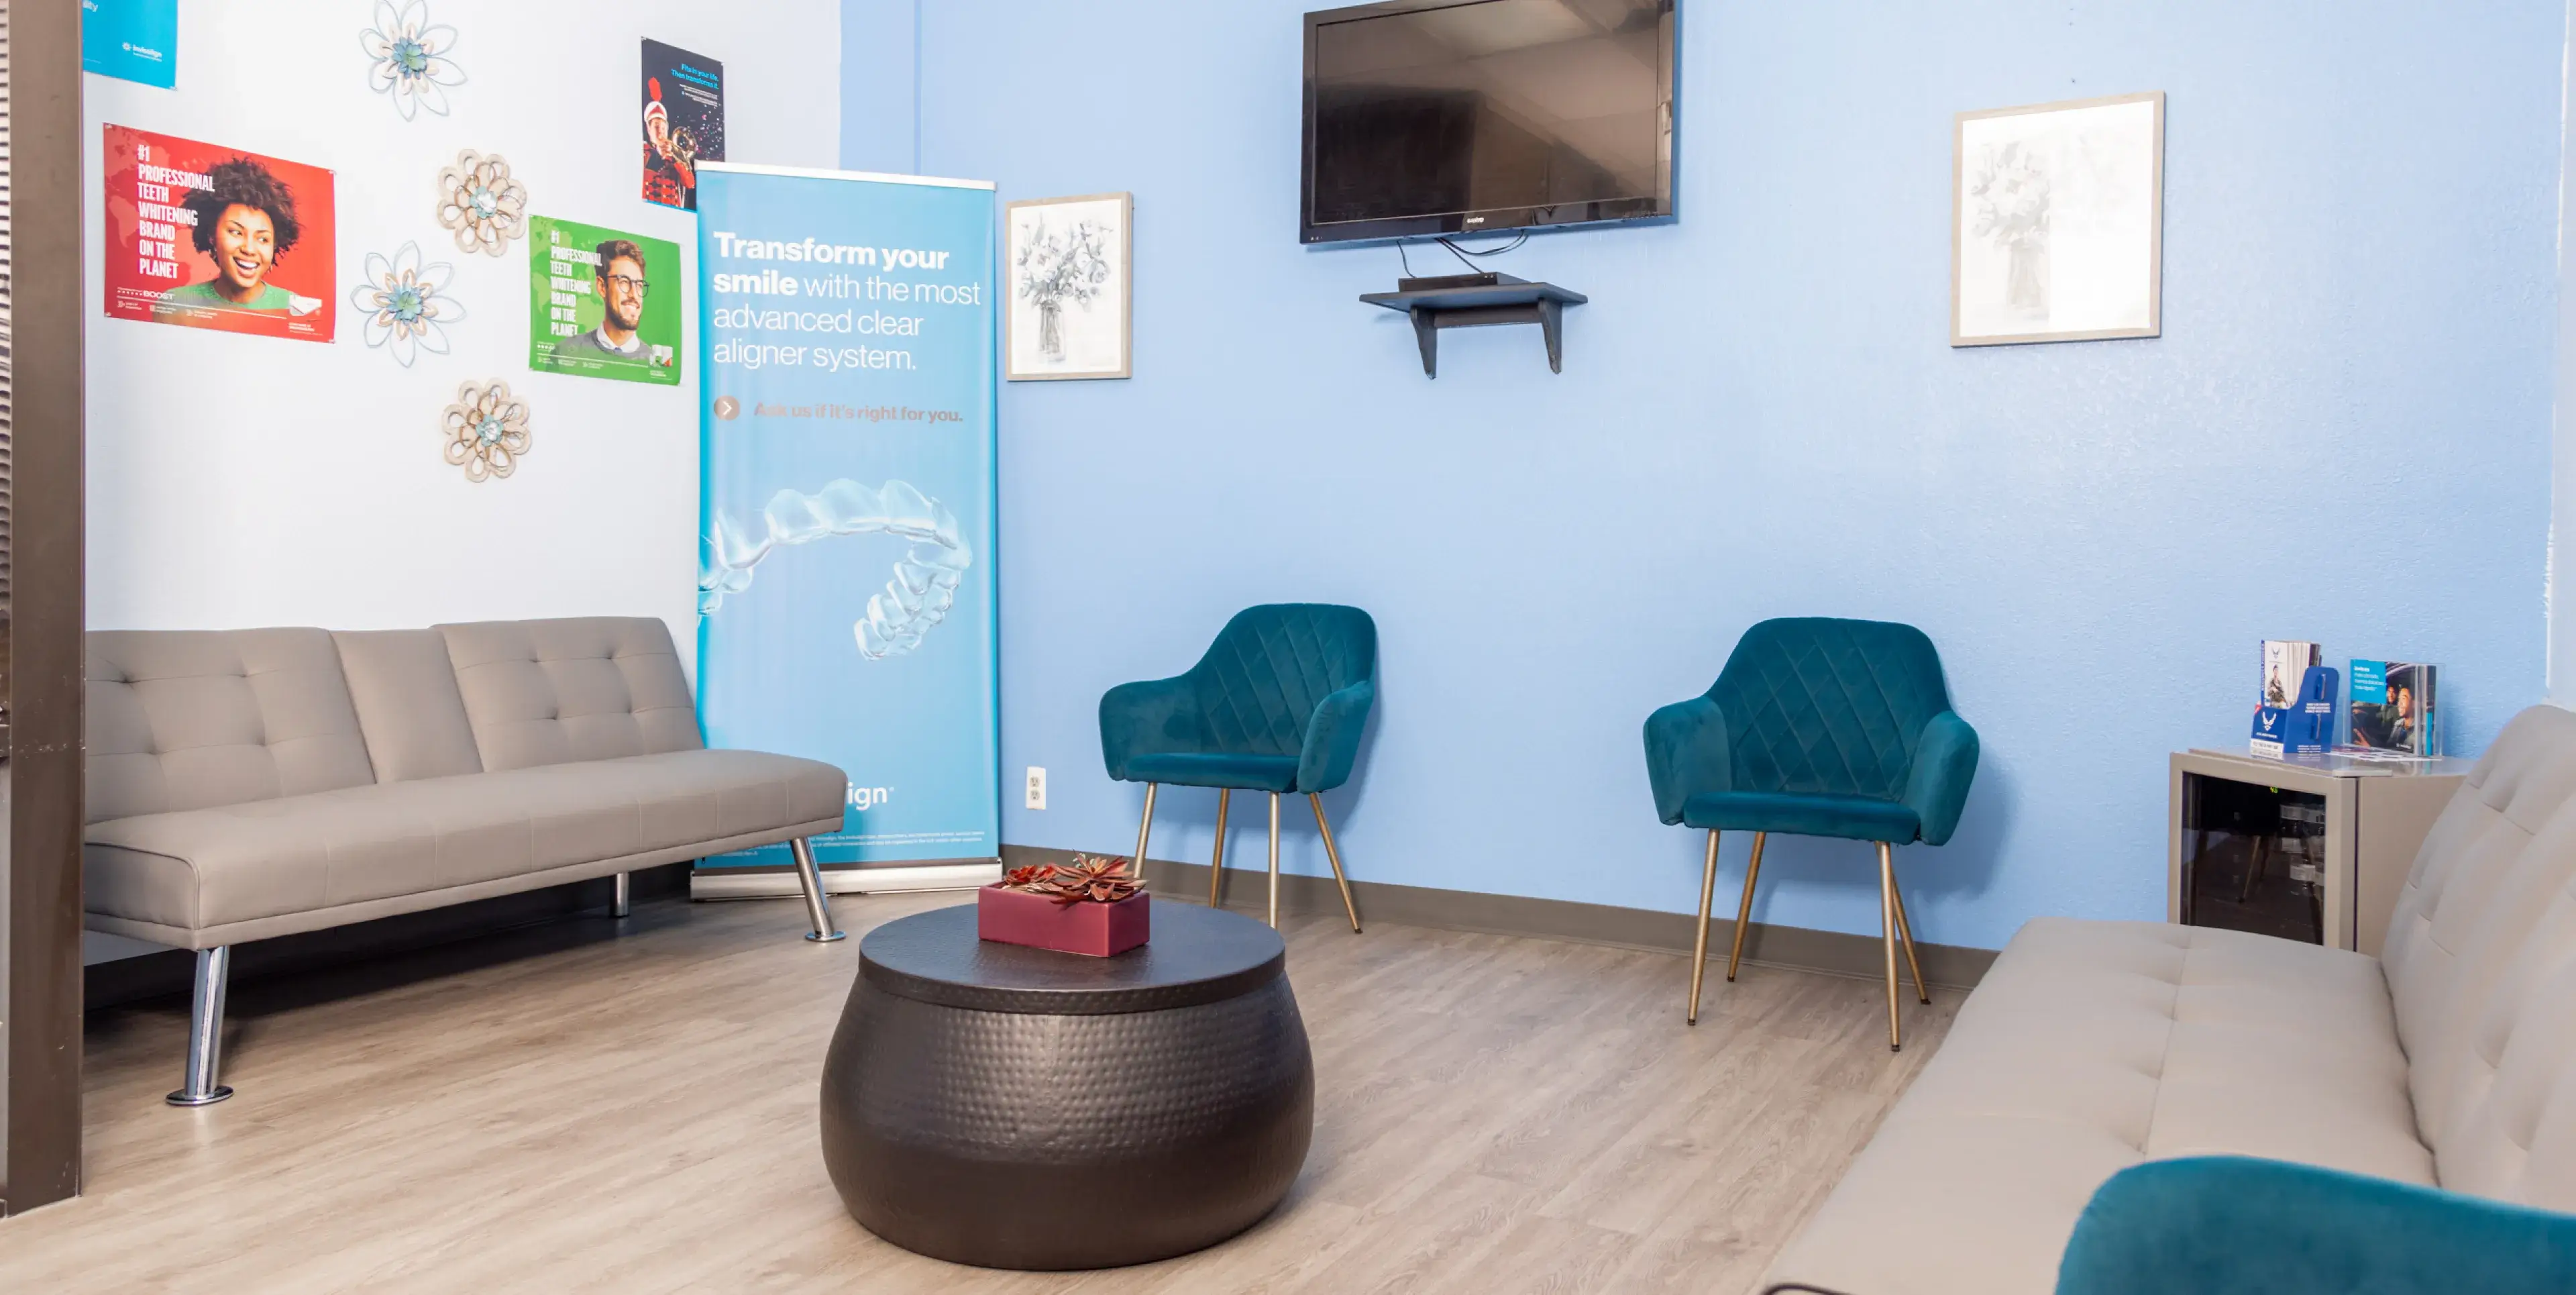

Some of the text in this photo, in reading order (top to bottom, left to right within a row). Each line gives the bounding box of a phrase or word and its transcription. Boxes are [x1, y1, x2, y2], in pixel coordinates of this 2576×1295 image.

[138, 144, 150, 162] #1
[138, 163, 215, 193] PROFESSIONAL
[138, 182, 169, 203] TEETH
[138, 201, 199, 226] WHITENING
[139, 220, 175, 241] BRAND
[139, 239, 175, 260] ON THE
[551, 246, 602, 266] PROFESSIONAL
[713, 231, 950, 271] Transform your
[139, 258, 178, 278] PLANET
[550, 260, 572, 276] TEETH
[143, 289, 174, 300] BOOST
[550, 276, 591, 295] WHITENING
[713, 269, 981, 305] smile with the most
[551, 291, 576, 307] BRAND
[551, 306, 576, 322] ON THE
[713, 303, 924, 336] advanced clear
[551, 322, 578, 337] PLANET
[713, 338, 916, 372] aligner system.
[754, 402, 963, 423] Ask us if it's right for you.
